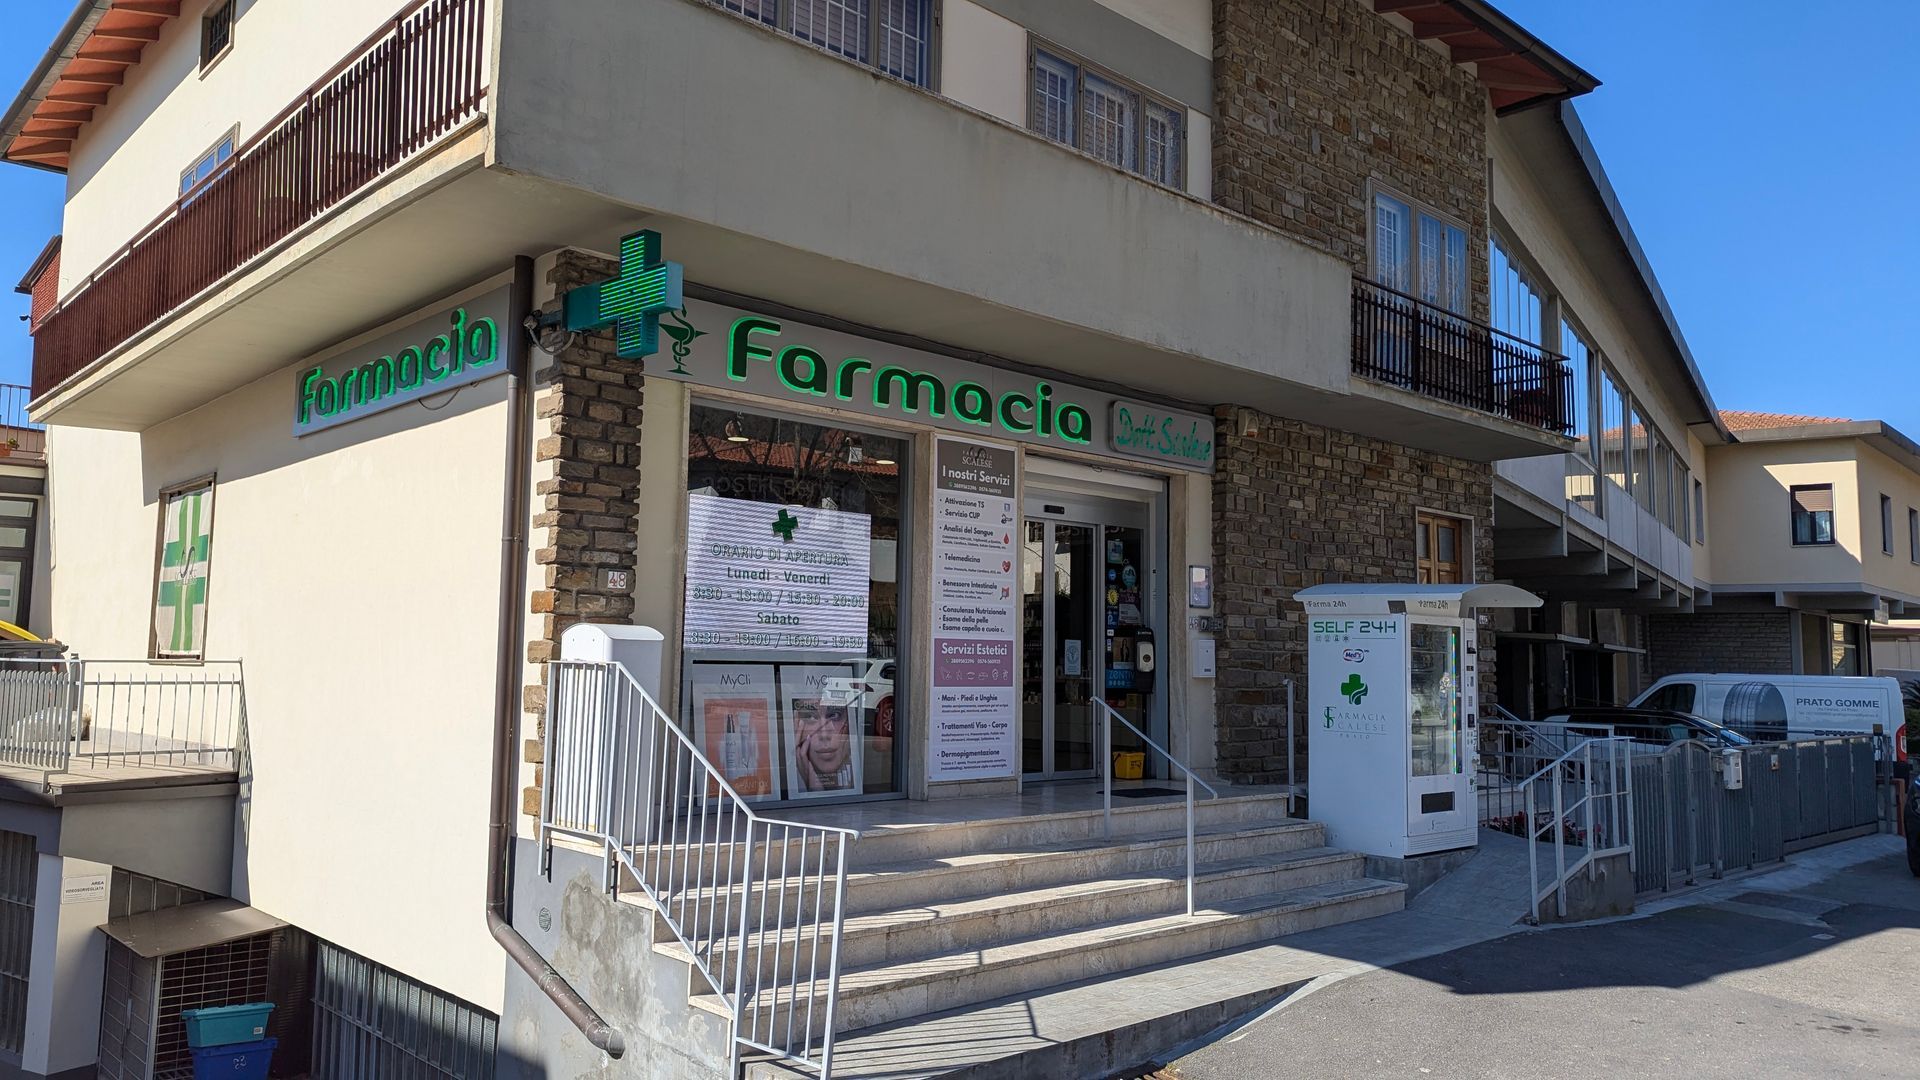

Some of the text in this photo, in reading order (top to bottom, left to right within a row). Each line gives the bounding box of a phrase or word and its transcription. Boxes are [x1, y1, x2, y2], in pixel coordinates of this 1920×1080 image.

[297, 308, 498, 425] Farmacia
[727, 316, 1092, 445] Farmacia
[962, 456, 993, 468] SCALESE
[942, 465, 1010, 486] I nostri Servizi
[944, 497, 985, 509] Attivazione TS
[944, 509, 981, 520] Servizio CUP
[943, 524, 994, 538] Analisi del Sangue
[711, 542, 849, 567] ORARIO DI APERTURA
[944, 553, 981, 563] Telemedicina
[610, 571, 626, 588] 48
[727, 565, 770, 582] Lunedì
[783, 570, 831, 586] Venerdì
[942, 579, 998, 590] Benessere Intestinale
[692, 585, 723, 601] 8:30
[1307, 600, 1347, 608] Farma 24h
[1438, 600, 1449, 610] 24h
[942, 605, 1007, 616] Consulenza Nutrizionale
[756, 611, 800, 626] Sabato
[976, 616, 989, 625] pelle
[962, 625, 981, 633] capello
[1313, 621, 1396, 634] SELF 24H
[690, 631, 721, 645] 8:30
[941, 642, 1008, 656] Servizi Estetici
[720, 673, 751, 689] MyCli
[942, 694, 956, 702] Mani
[960, 694, 974, 702] Piedi
[979, 694, 998, 704] Unghie
[1796, 698, 1880, 708] PRATO GOMME
[941, 722, 975, 730] Trattamenti
[975, 721, 987, 730] Viso
[992, 721, 1008, 730] Corpo
[941, 749, 1000, 759] Dermopigmentazione
